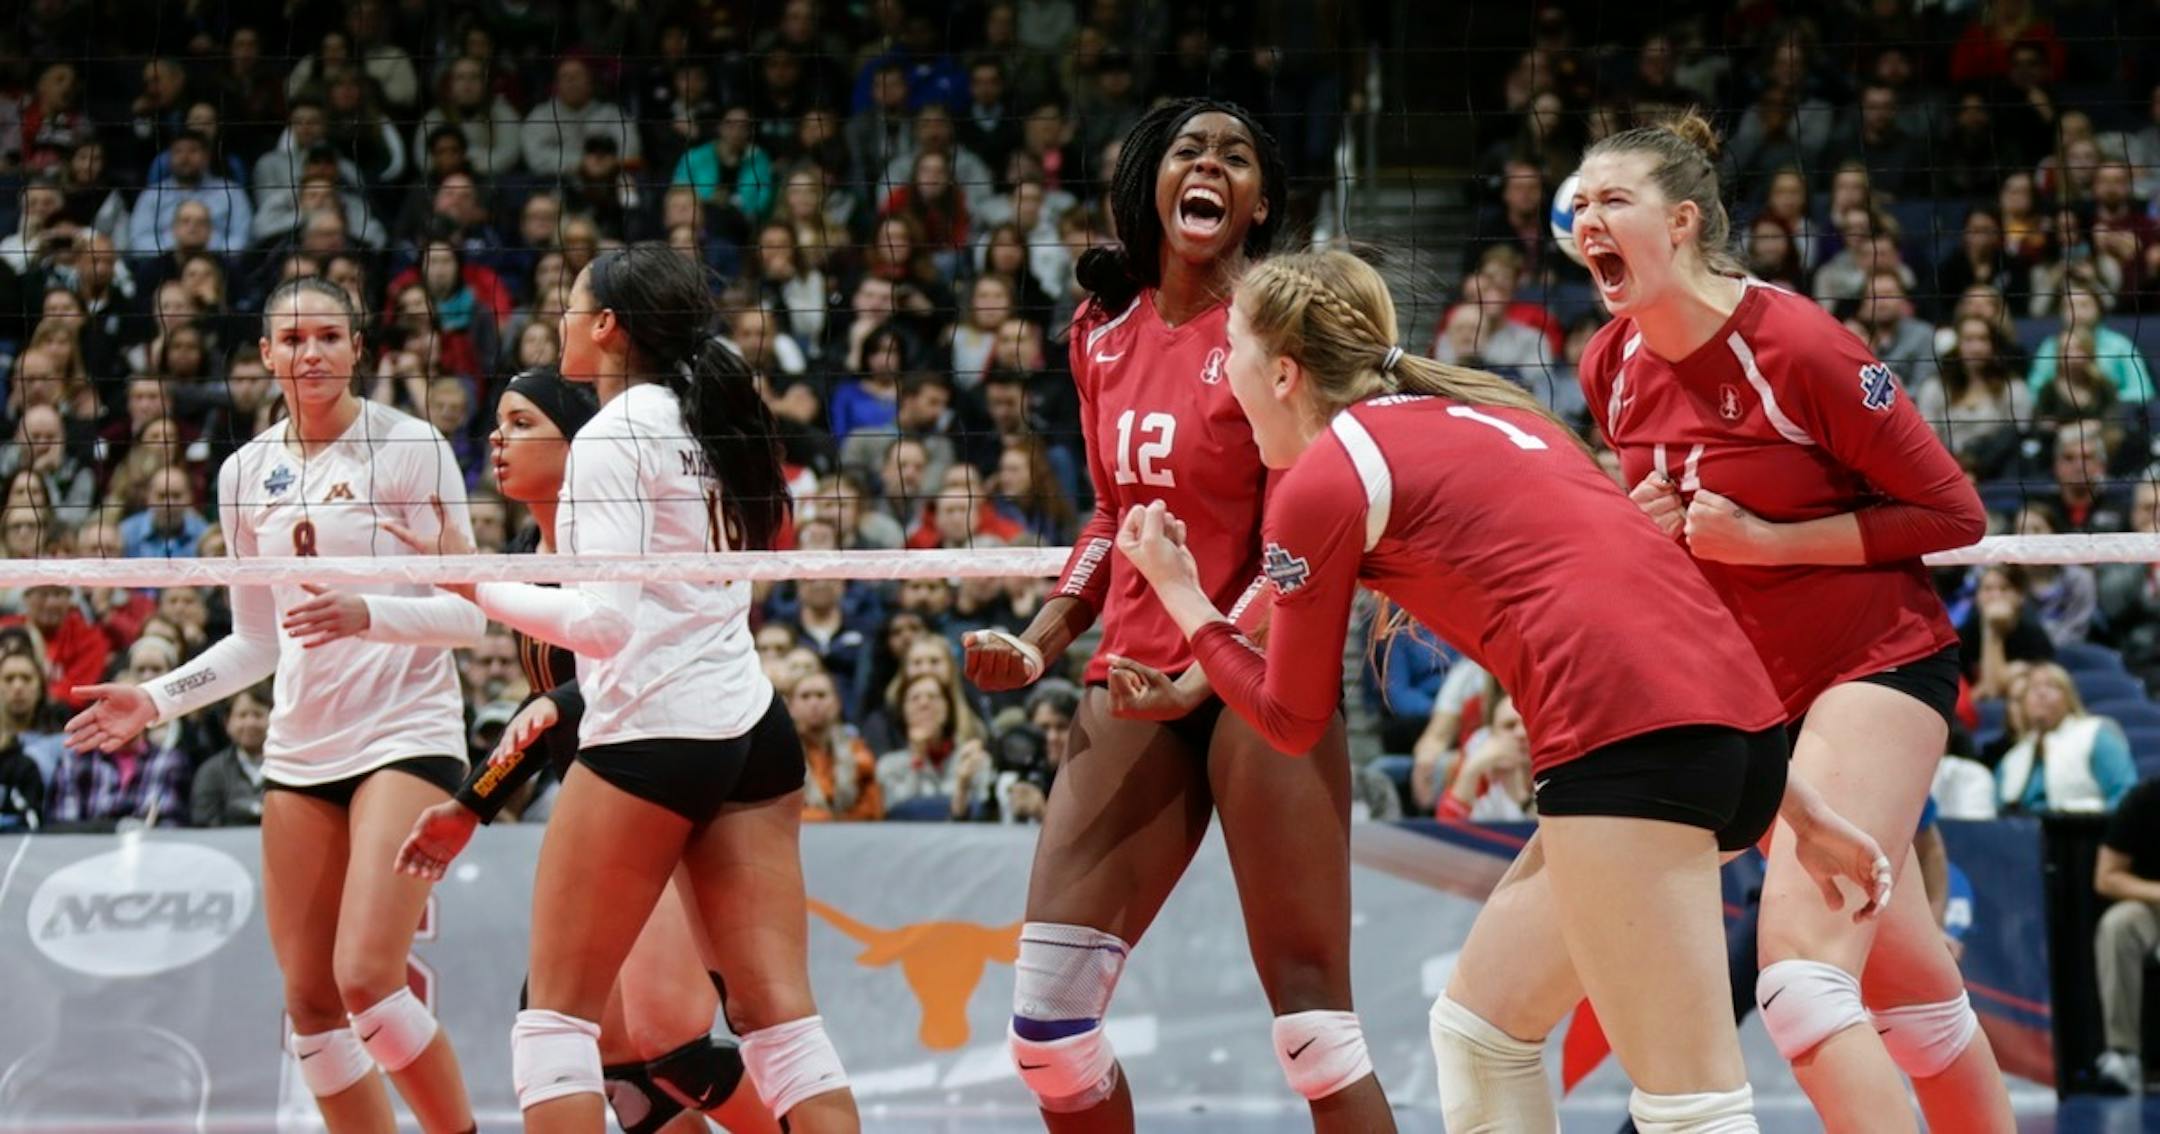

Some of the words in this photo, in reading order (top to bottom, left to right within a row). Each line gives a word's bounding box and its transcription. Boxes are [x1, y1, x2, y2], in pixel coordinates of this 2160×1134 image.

[1115, 410, 1176, 487] 12
[1446, 406, 1549, 449] 1
[1060, 537, 1113, 595] STANFORD
[39, 890, 235, 940] NCAA
